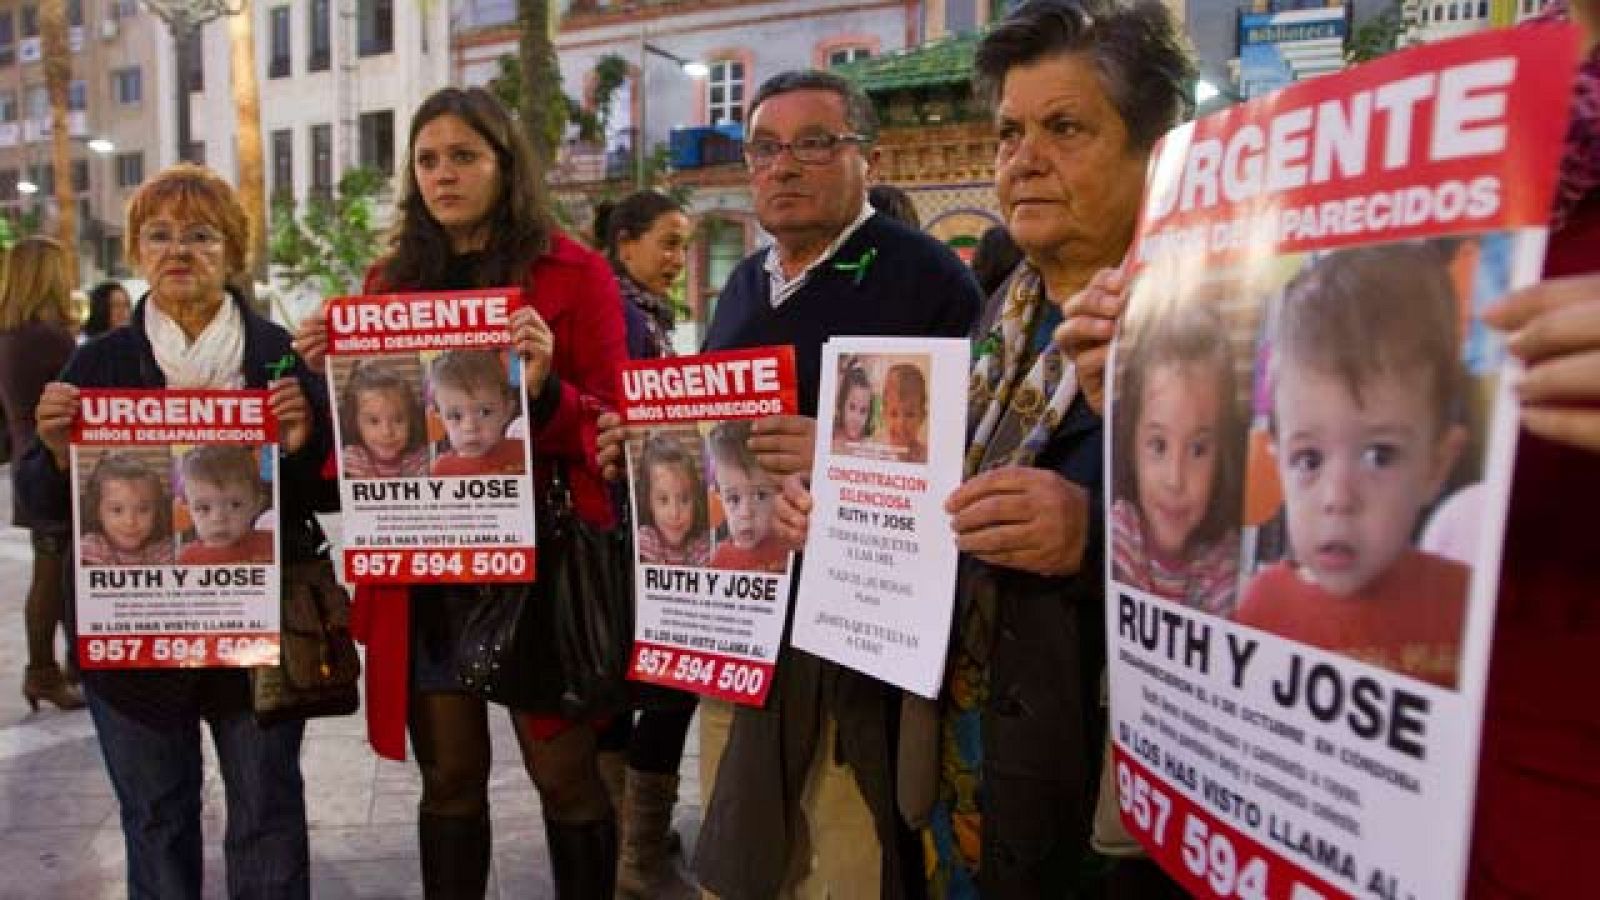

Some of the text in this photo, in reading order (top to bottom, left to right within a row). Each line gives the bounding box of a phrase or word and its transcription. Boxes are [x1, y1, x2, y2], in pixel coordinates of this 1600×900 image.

[332, 297, 509, 333] URGENTE
[385, 331, 511, 348] DESAPARECIDOS
[622, 357, 781, 401] URGENTE
[82, 397, 264, 424] URGENTE
[665, 399, 781, 418] DESAPARECIDOS
[135, 429, 266, 441] DESAPARECIDOS
[353, 480, 519, 500] RUTH Y JOSE
[828, 466, 928, 493] CONCENTRACION
[839, 487, 911, 510] SILENCIOSA
[838, 507, 916, 532] RUTH Y JOSE
[353, 552, 526, 576] 957 594 500
[89, 568, 266, 588] RUTH Y JOSE
[645, 568, 778, 601] RUTH Y JOSE
[87, 639, 143, 662] 957
[153, 639, 206, 661] 594
[635, 648, 763, 696] 957 594 500
[1119, 593, 1211, 675] RUTH
[1225, 633, 1260, 689] Y
[1272, 654, 1432, 761] JOSE
[1242, 706, 1305, 746] OCTUBRE
[1133, 731, 1160, 768] LOS
[1165, 750, 1197, 792] HAS
[1202, 774, 1262, 830] VISTO
[1268, 813, 1359, 885] LLAMA
[1118, 760, 1269, 900] 957 594
